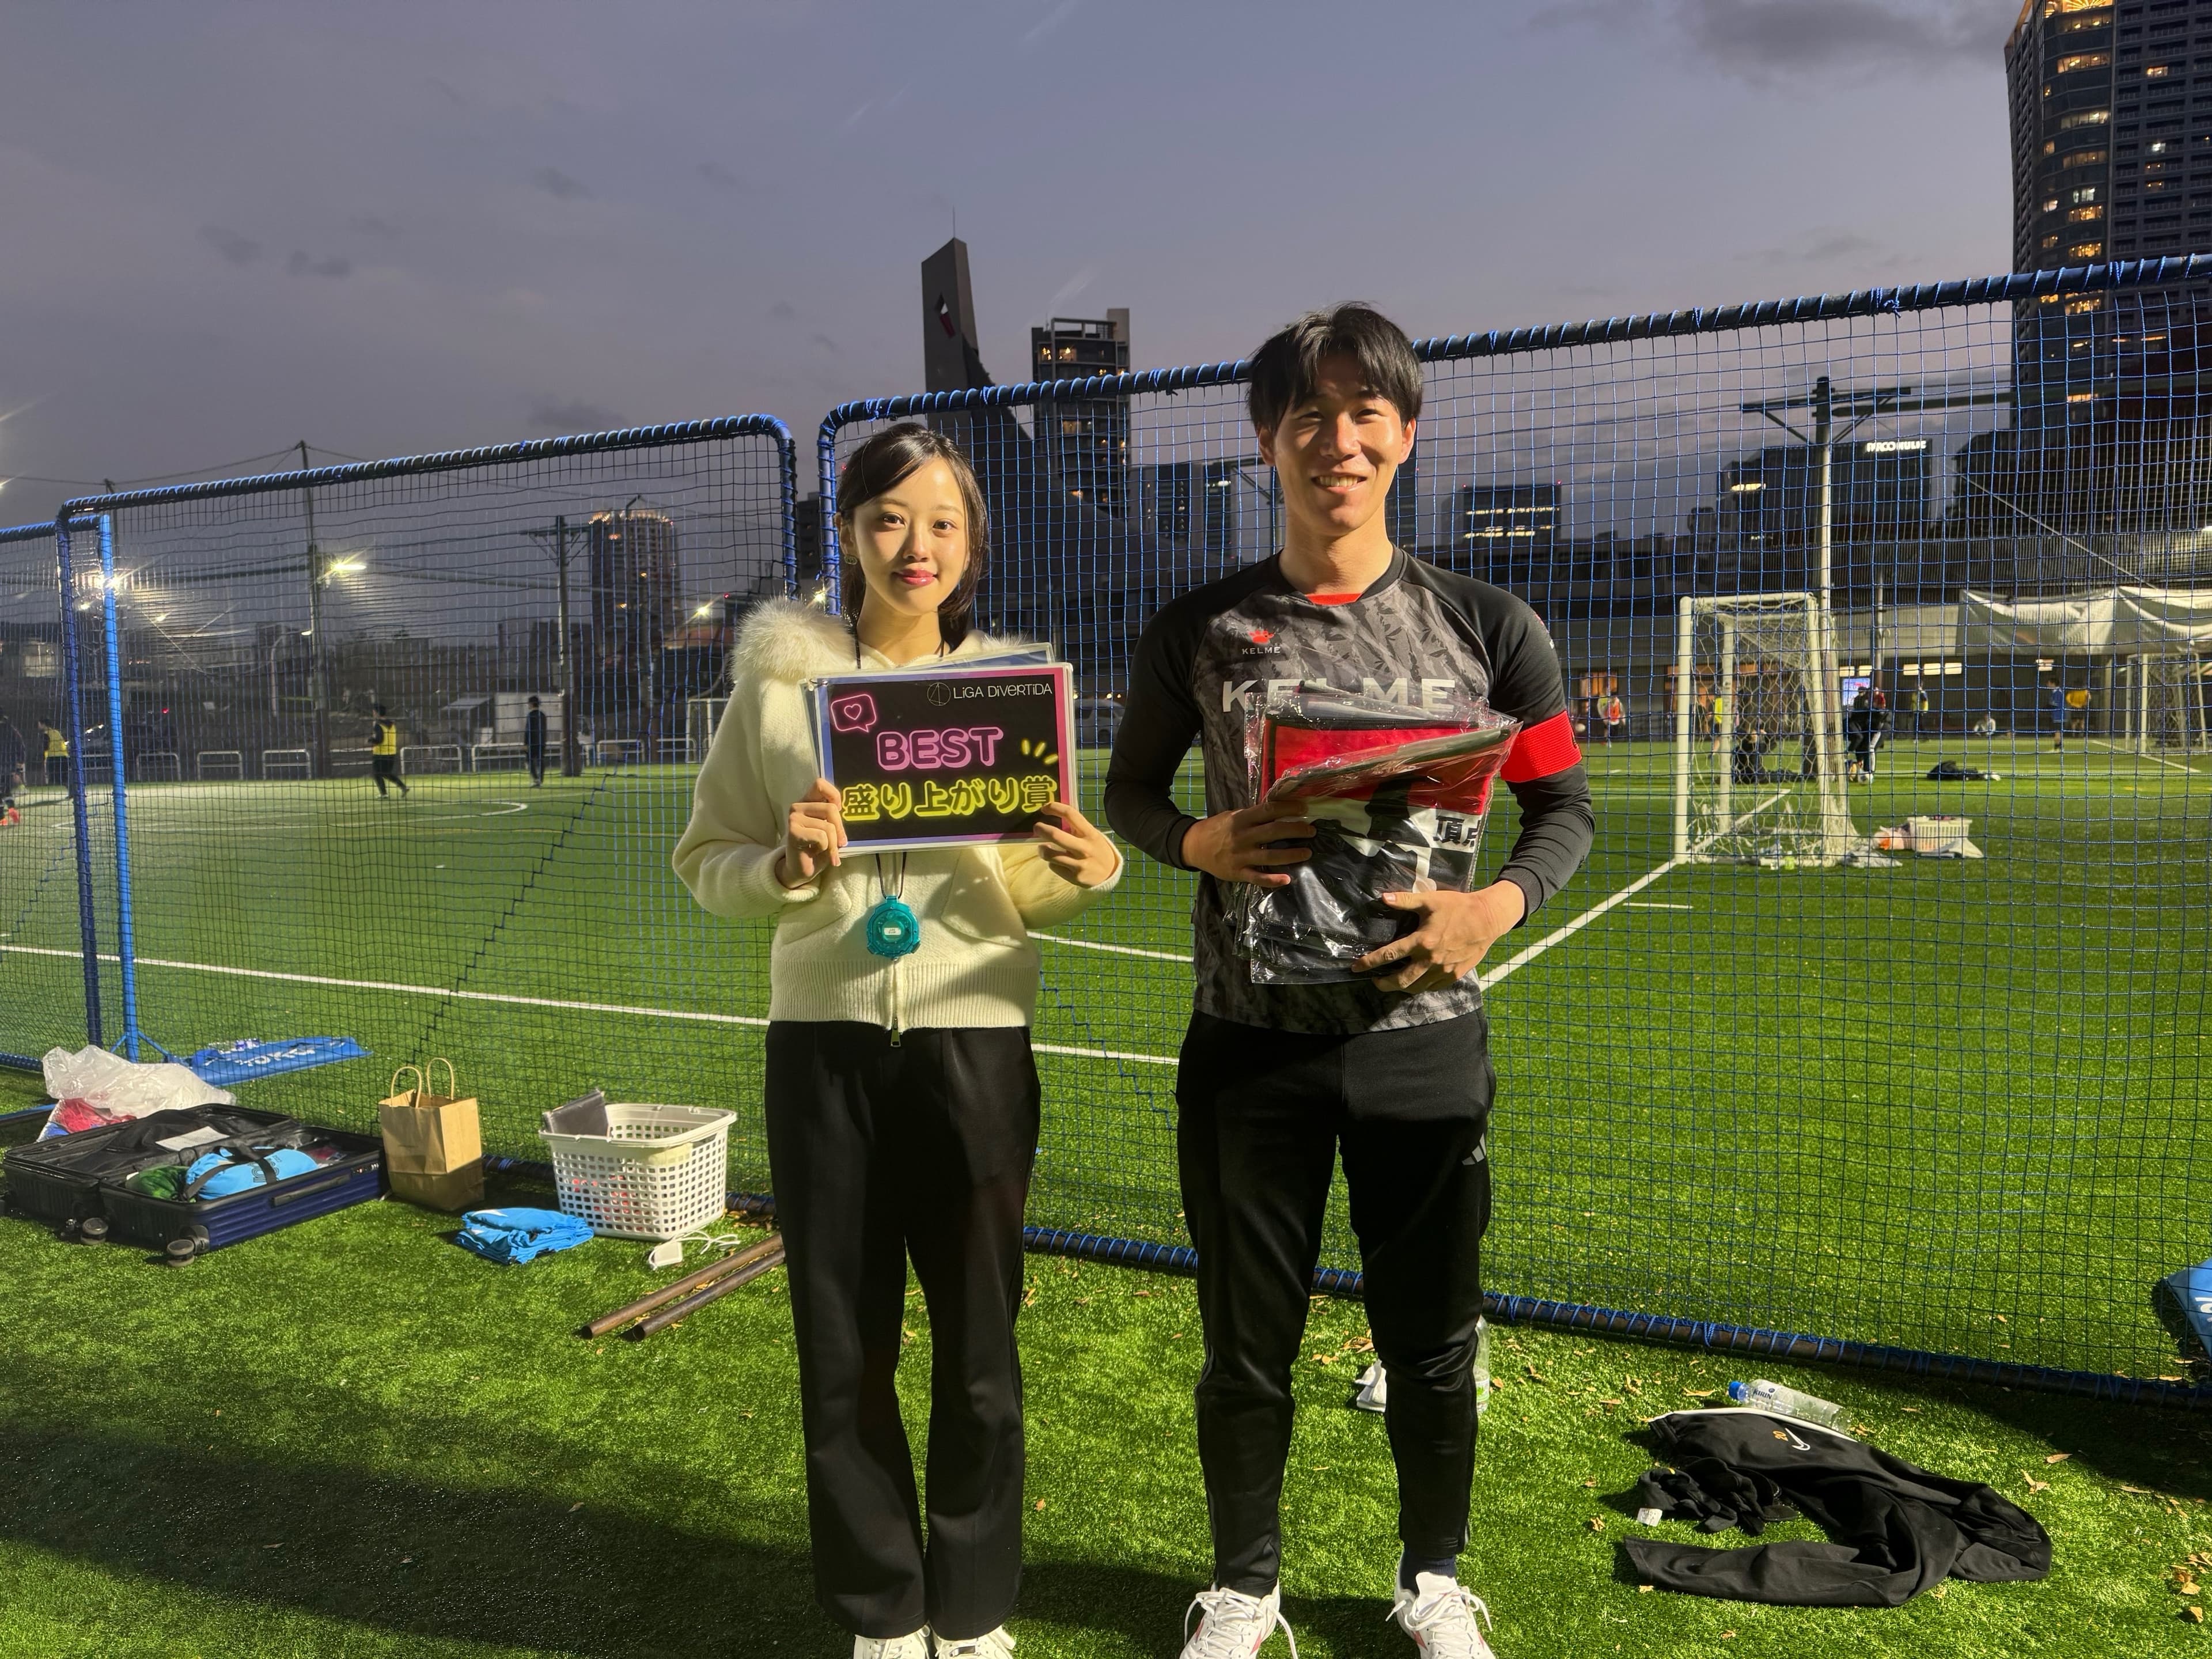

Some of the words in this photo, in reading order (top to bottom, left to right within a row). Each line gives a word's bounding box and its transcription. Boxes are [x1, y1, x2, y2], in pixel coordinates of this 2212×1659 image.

[1242, 646, 1281, 654] KELME
[877, 726, 1003, 771] BEST
[843, 775, 1056, 821] 盛り上がり賞
[1753, 1389, 1772, 1399] KIRIN
